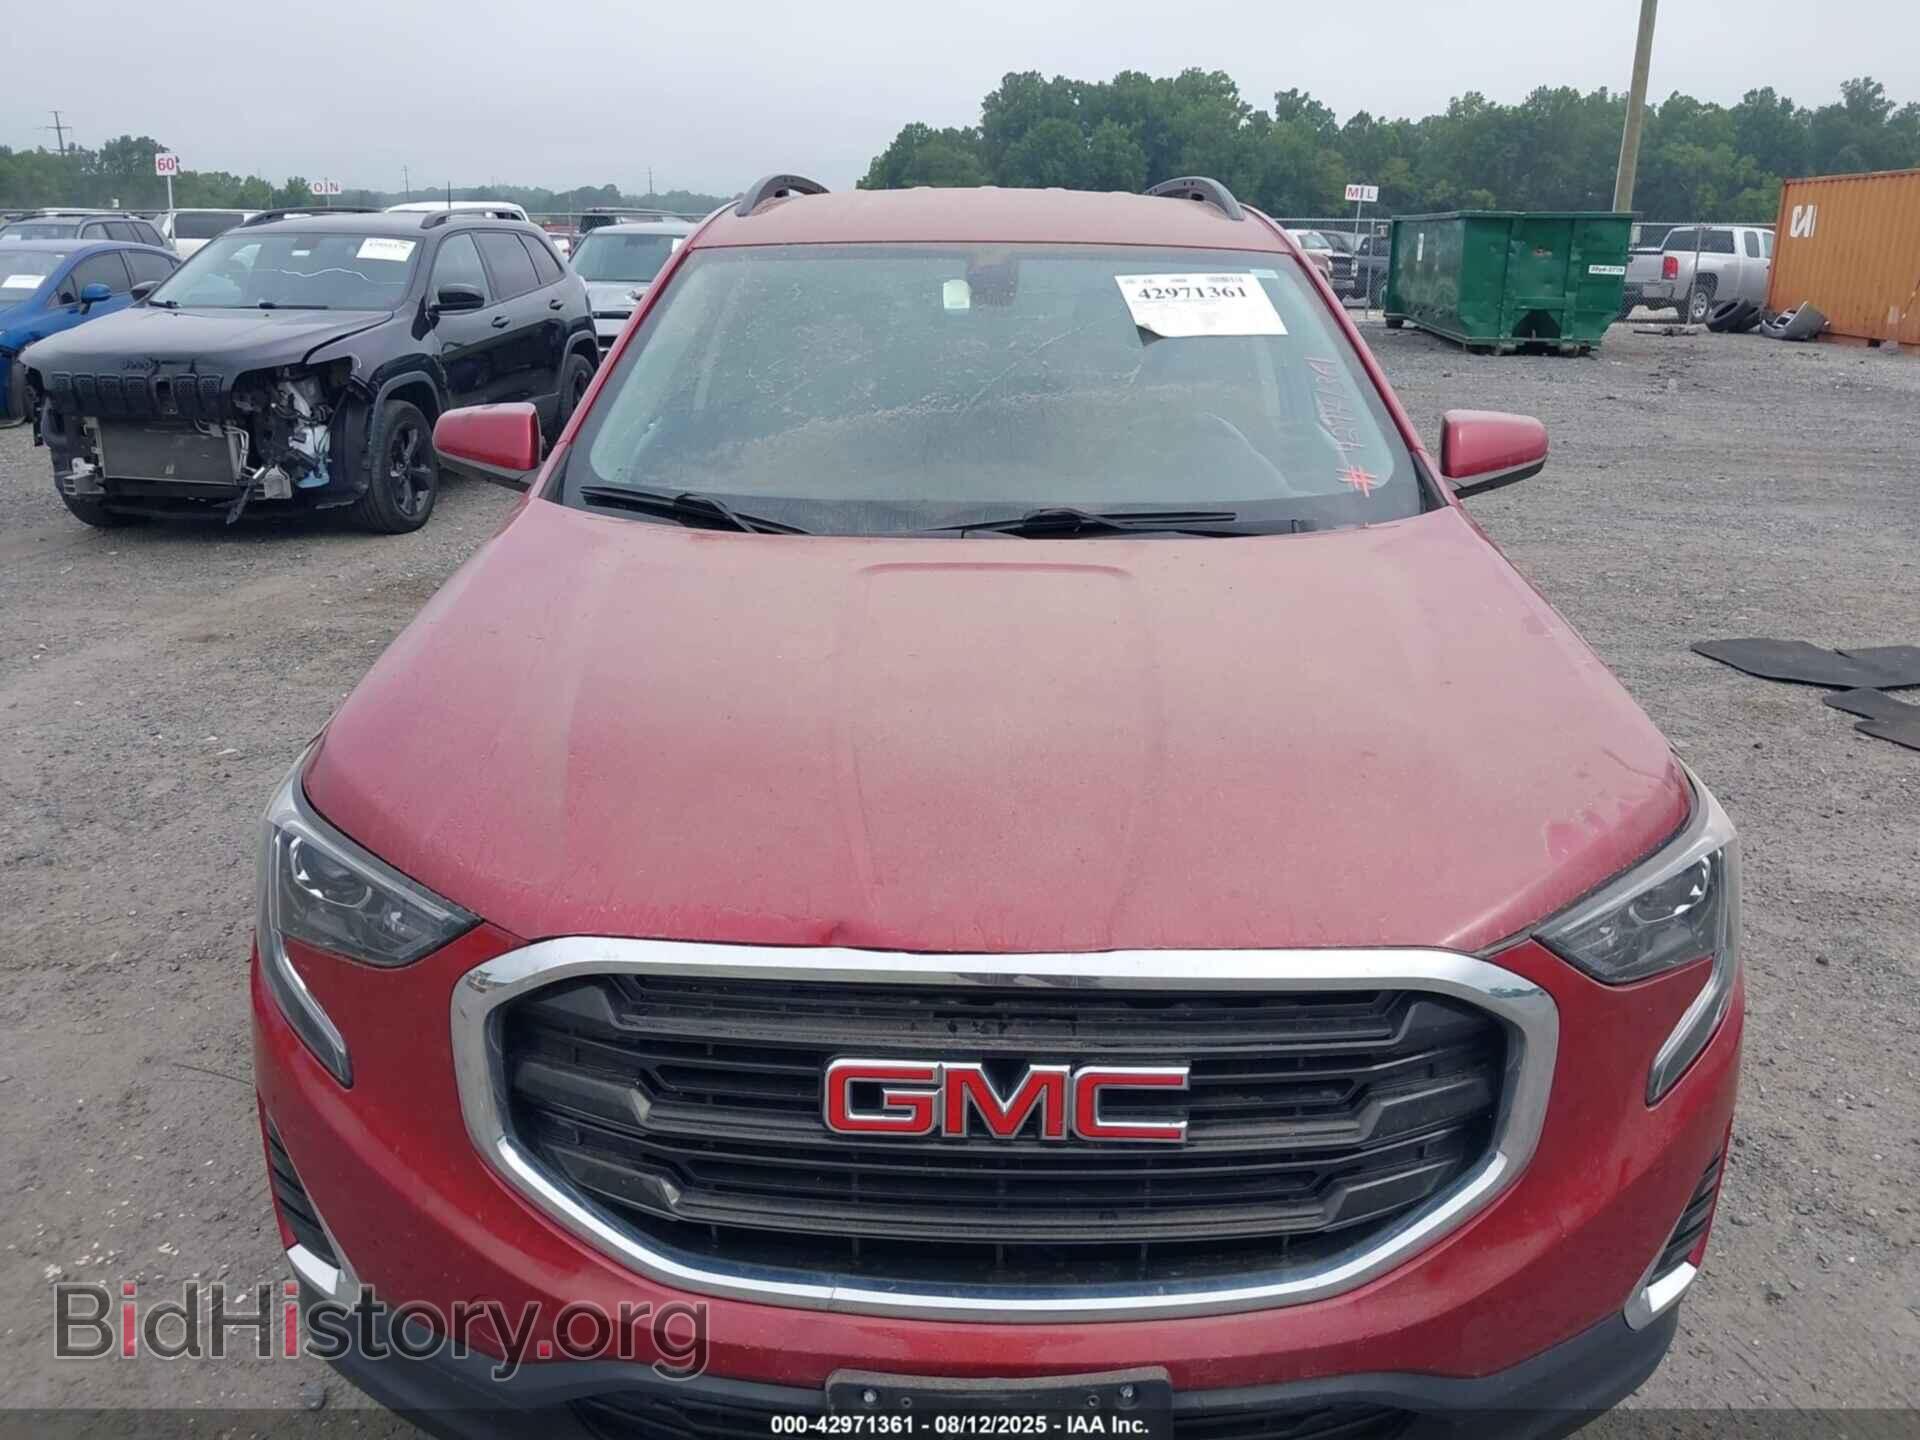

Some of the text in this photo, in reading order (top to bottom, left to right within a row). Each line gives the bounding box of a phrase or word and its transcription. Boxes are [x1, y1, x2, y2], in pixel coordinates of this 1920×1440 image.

[157, 157, 176, 171] 60
[1138, 286, 1248, 299] 42971361
[824, 1058, 1190, 1143] GMC
